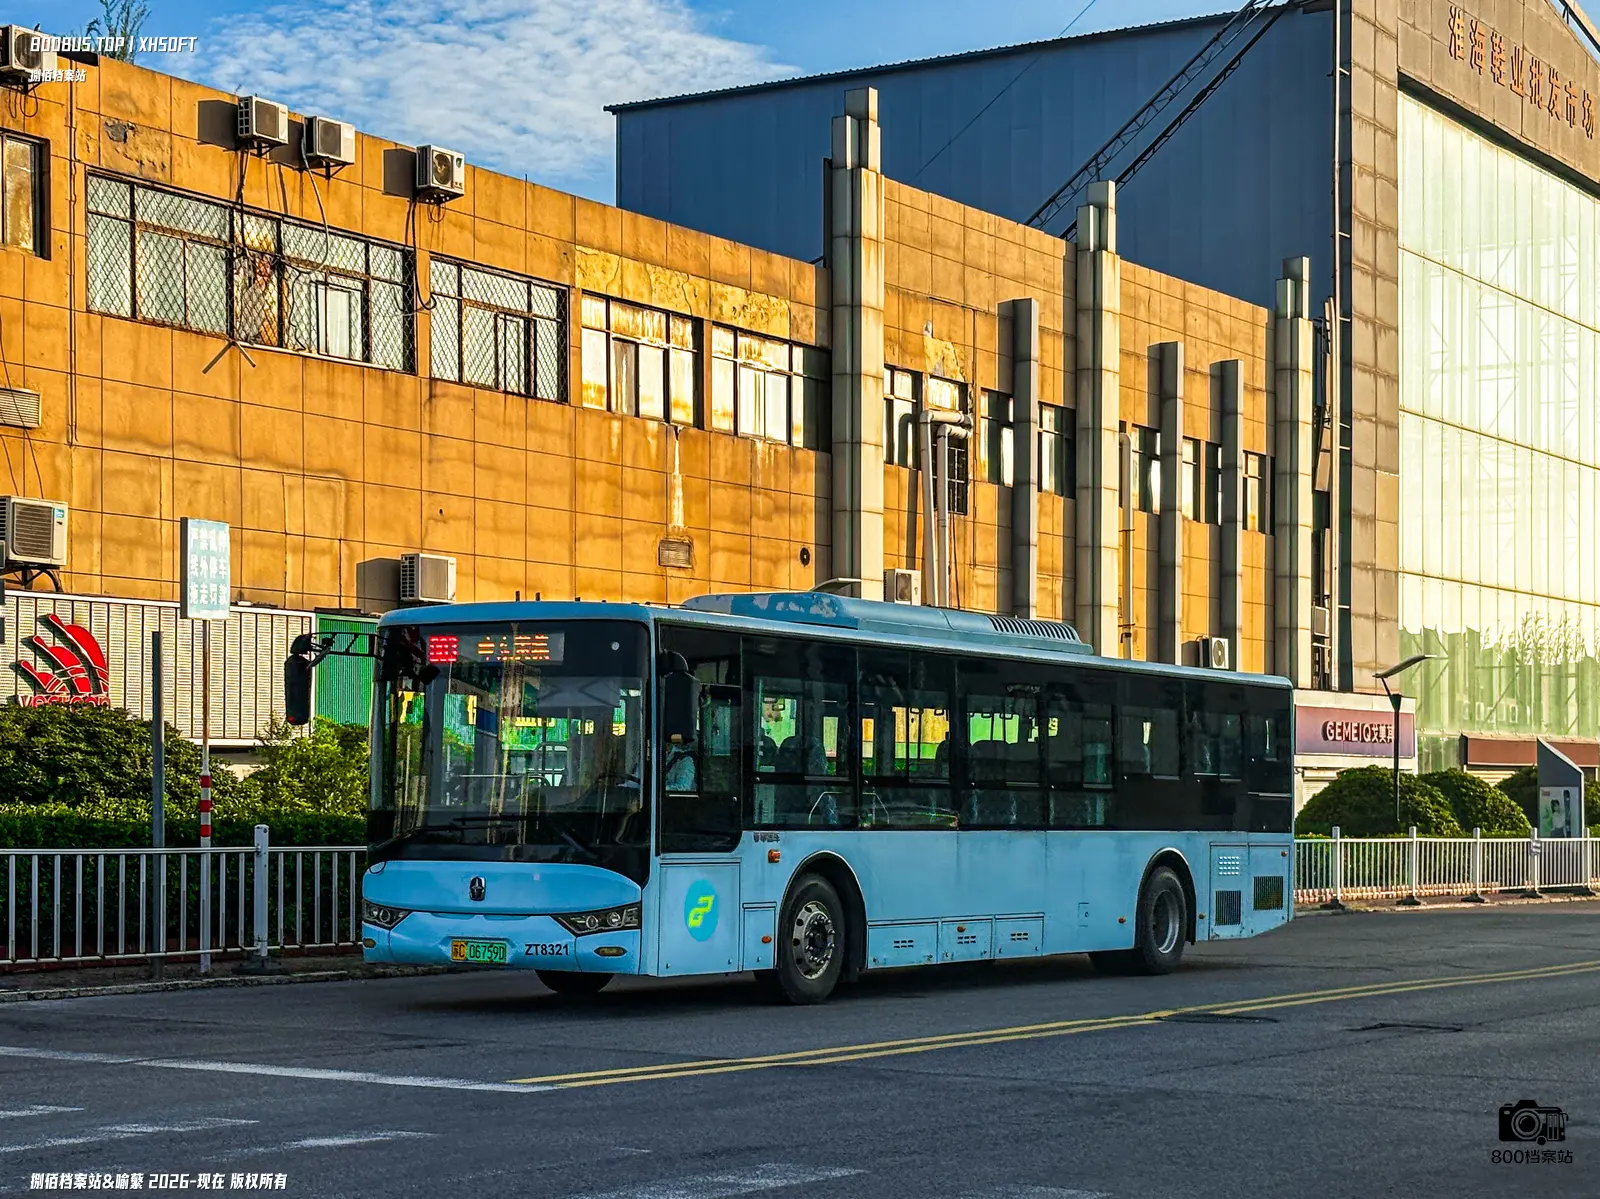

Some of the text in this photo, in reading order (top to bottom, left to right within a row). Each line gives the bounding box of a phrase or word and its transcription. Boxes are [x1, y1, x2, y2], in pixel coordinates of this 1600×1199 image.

[1448, 5, 1597, 140] 淮海鞋业批发市场
[524, 943, 570, 956] ZT8321
